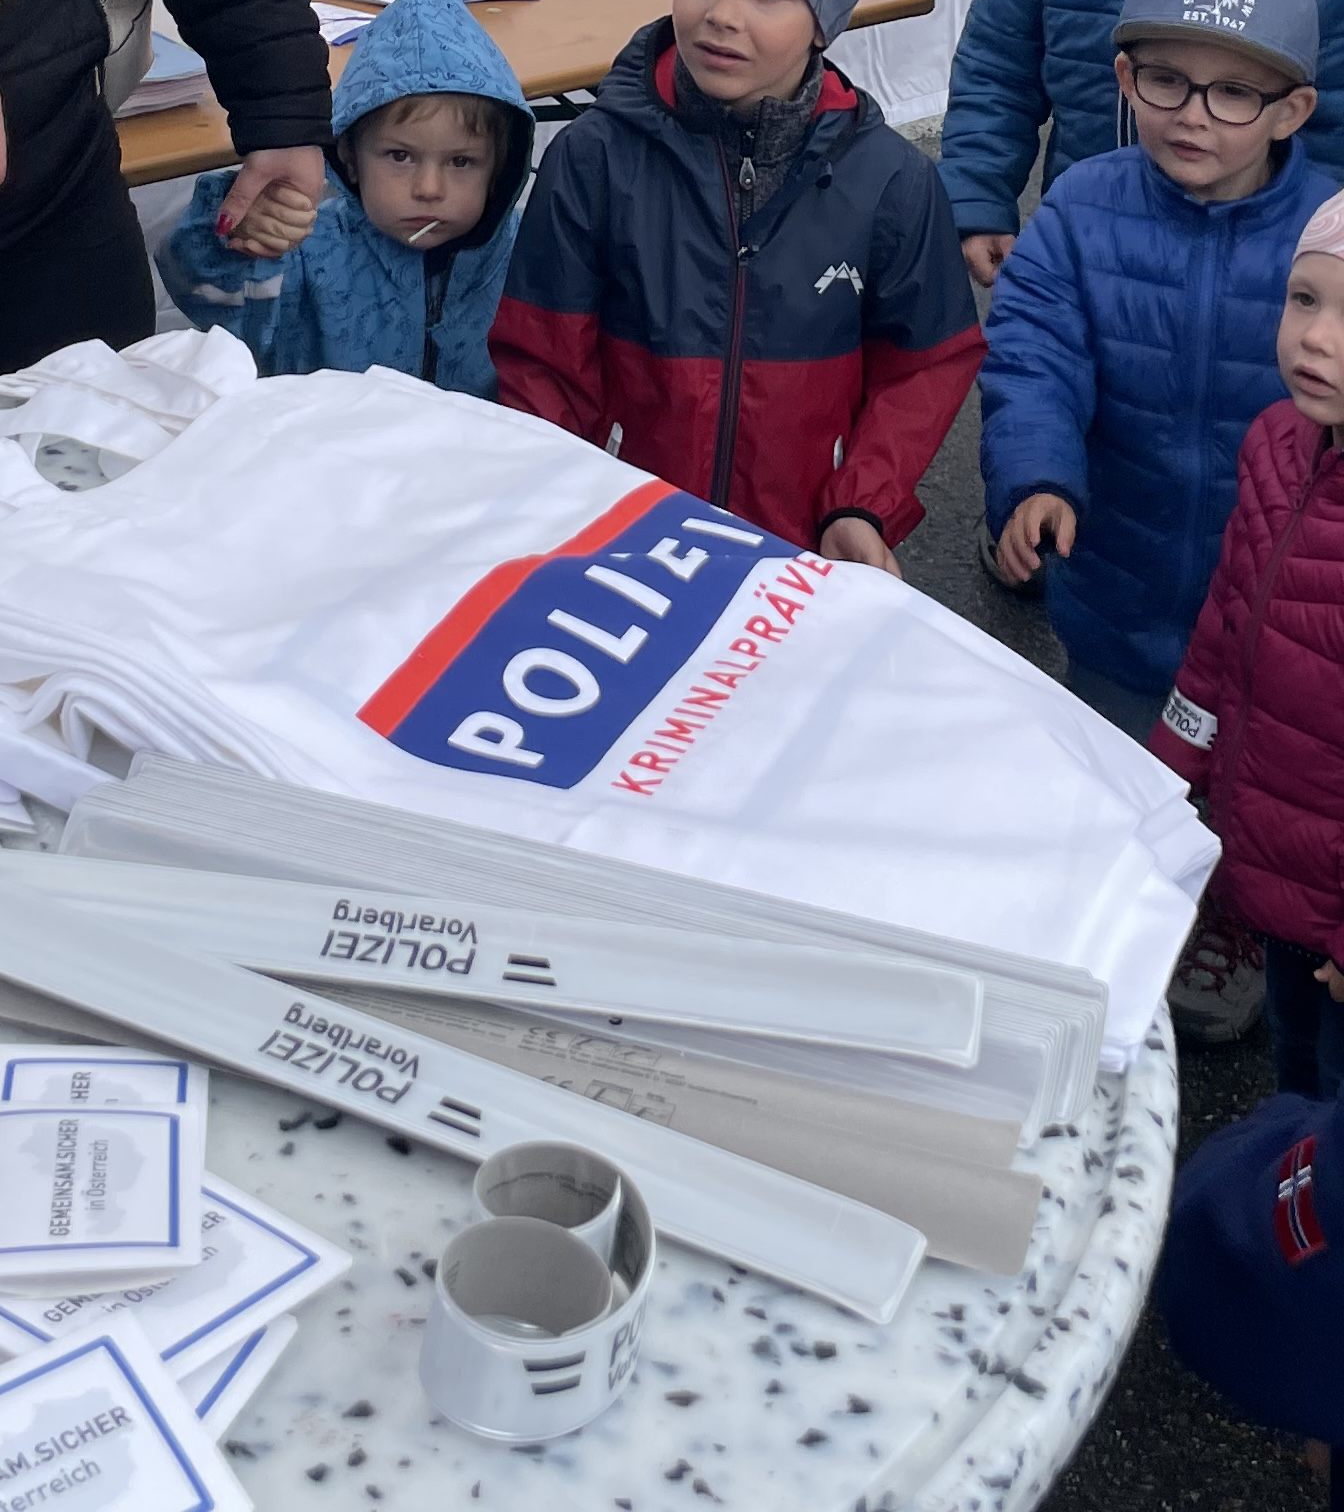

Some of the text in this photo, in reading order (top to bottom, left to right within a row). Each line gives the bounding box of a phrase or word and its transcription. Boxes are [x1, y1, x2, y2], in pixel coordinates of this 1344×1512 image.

[1183, 10, 1209, 24] EST.
[447, 516, 763, 769] POLIEI
[320, 929, 476, 975] POLIZEI
[333, 899, 478, 945] Vorarlberg
[257, 1029, 414, 1104] POLIZEI
[284, 1002, 420, 1079] Vorarlberg
[49, 1119, 80, 1237] GEMEINSAM.SICHER
[83, 1139, 109, 1211] in Österreich
